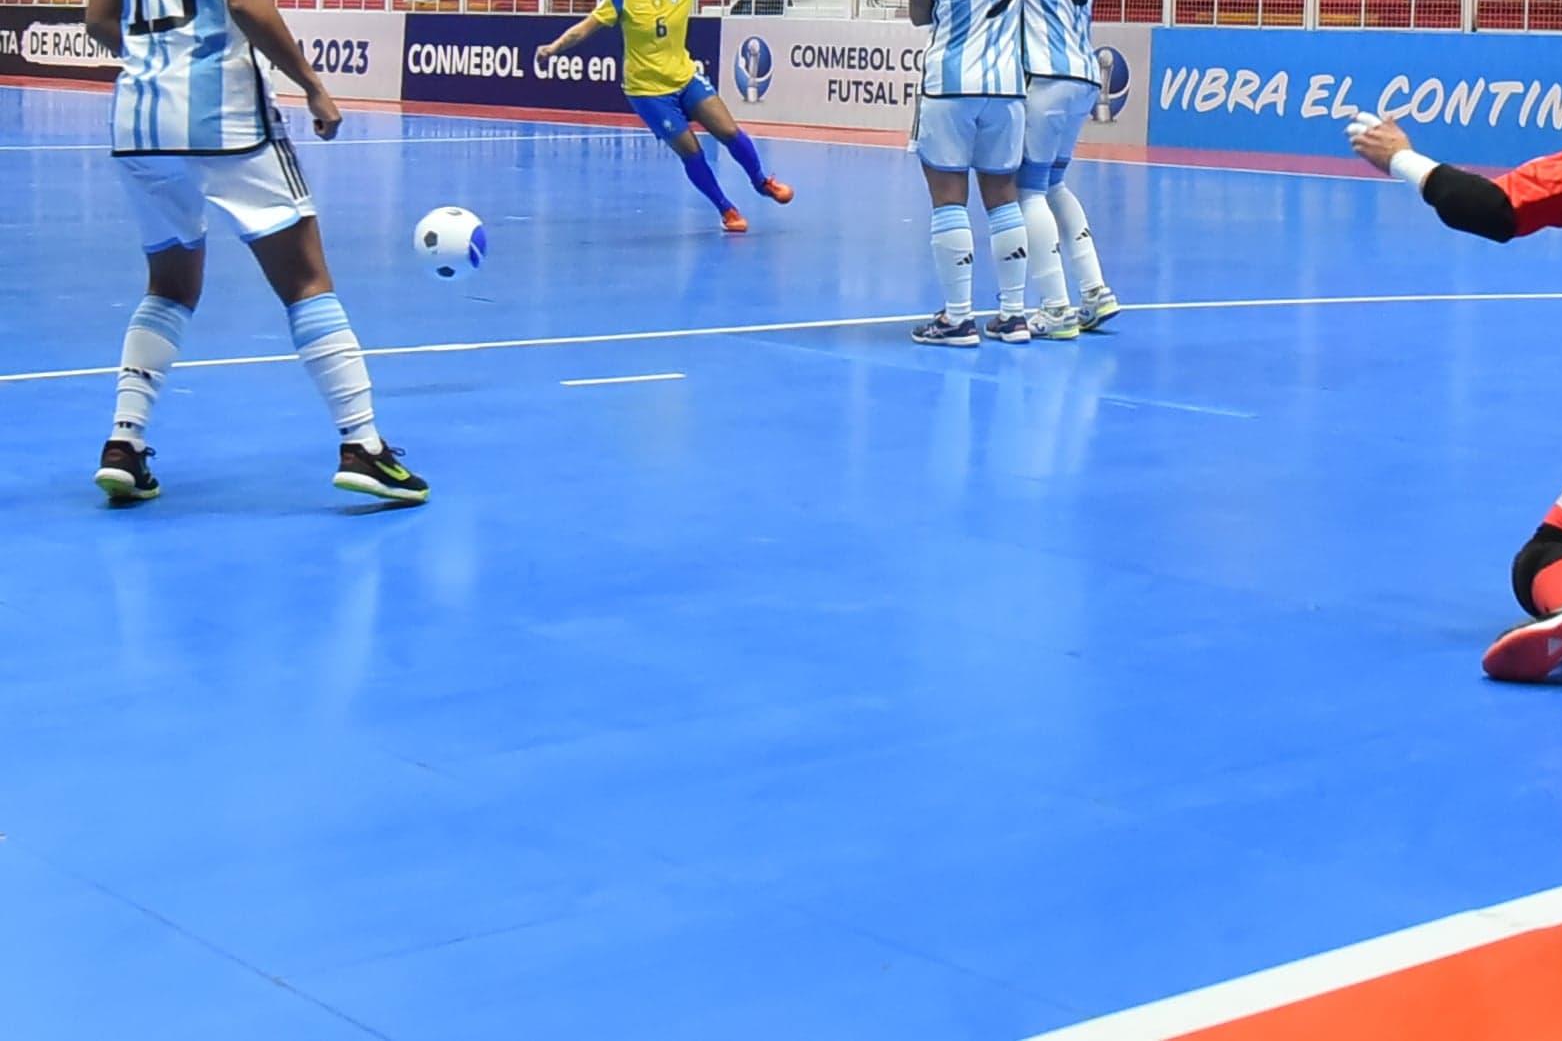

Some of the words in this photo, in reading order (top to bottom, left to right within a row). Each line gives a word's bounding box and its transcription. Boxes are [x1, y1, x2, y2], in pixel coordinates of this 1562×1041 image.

[656, 16, 668, 38] 6
[0, 31, 18, 54] TA
[30, 31, 48, 55] DE
[53, 32, 121, 58] RACISM
[312, 39, 369, 75] 2023
[408, 43, 524, 78] CONMEBOL
[588, 57, 617, 82] en
[790, 44, 897, 72] CONMEBOL
[828, 79, 898, 105] FUTSAL
[1159, 66, 1288, 116] VIBRA
[1300, 74, 1360, 119] EL
